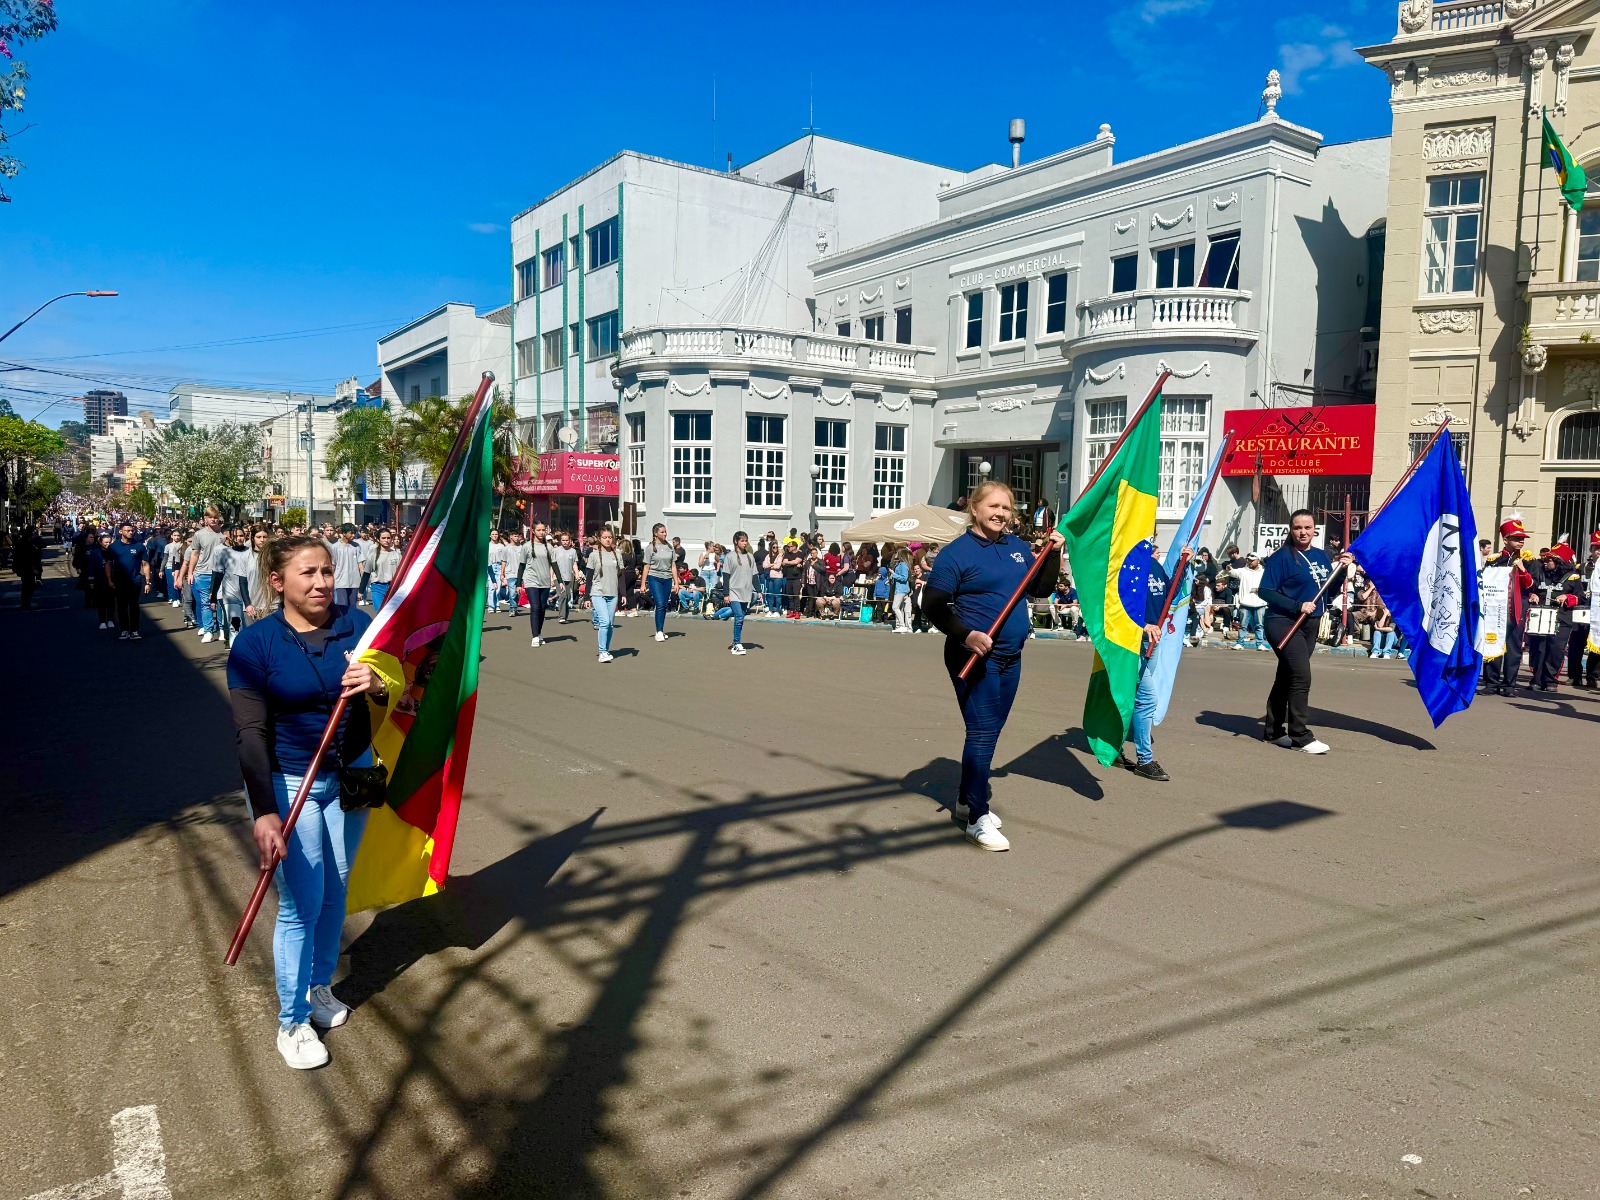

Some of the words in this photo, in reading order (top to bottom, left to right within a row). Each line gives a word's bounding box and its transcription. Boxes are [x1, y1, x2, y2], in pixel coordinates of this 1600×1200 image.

[1235, 436, 1361, 452] RESTAURANTE
[1288, 459, 1321, 467] CLUBE
[571, 473, 618, 483] EXCLUSIVA
